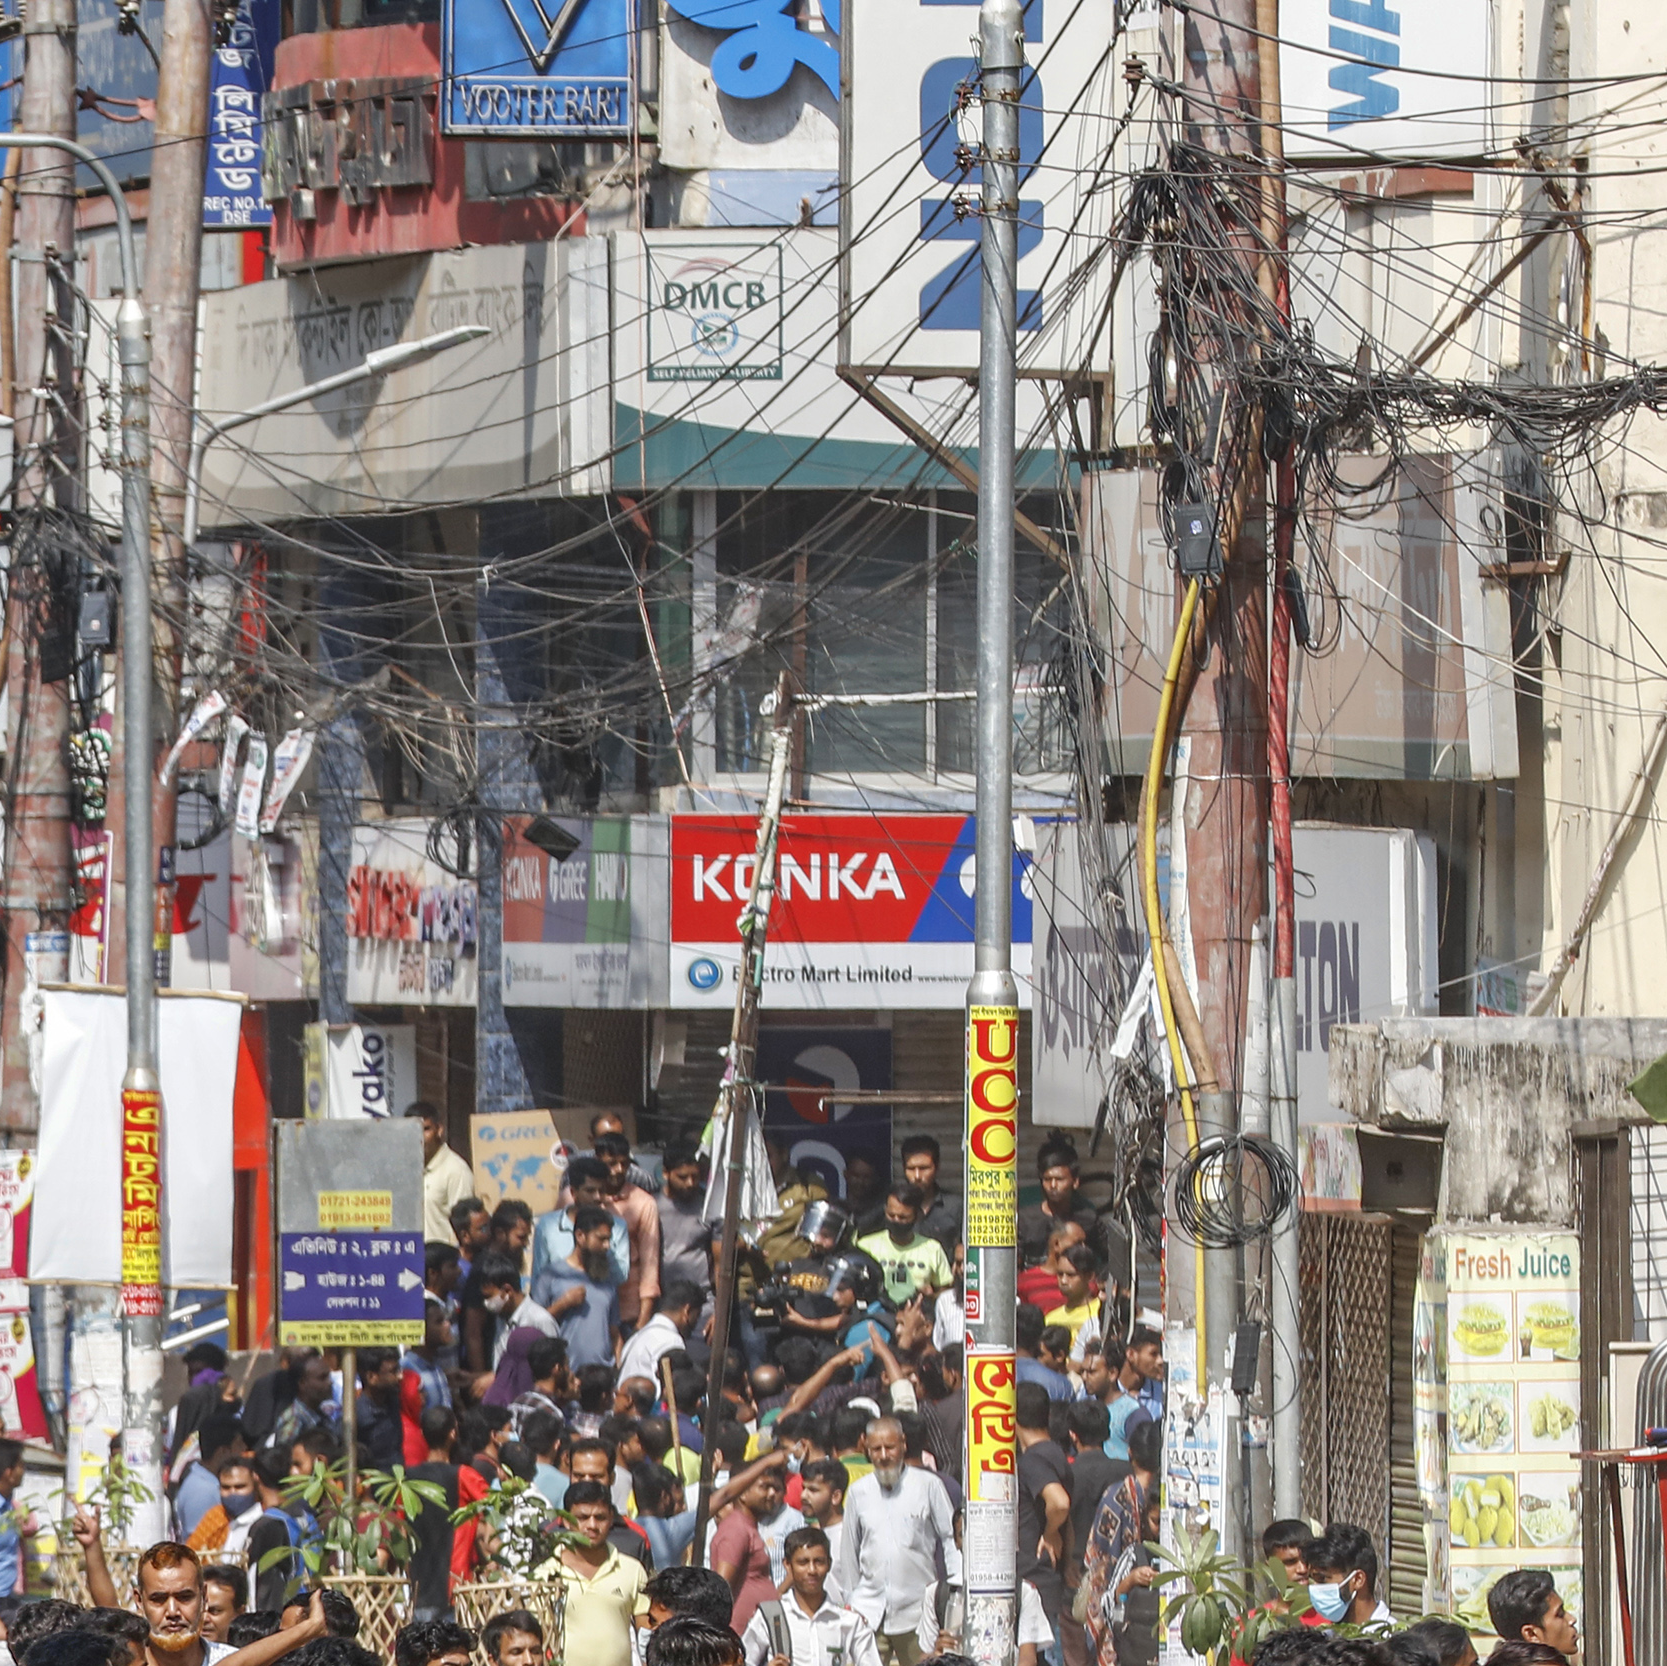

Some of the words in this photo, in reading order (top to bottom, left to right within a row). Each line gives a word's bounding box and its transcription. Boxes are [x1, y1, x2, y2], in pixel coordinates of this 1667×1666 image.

[222, 211, 250, 223] DSE
[663, 282, 767, 310] DMCB
[801, 966, 841, 983] Mart
[846, 965, 913, 984] Limited
[971, 1018, 1018, 1166] UCC
[1455, 1247, 1512, 1278] Fresh
[1518, 1247, 1572, 1277] Juice
